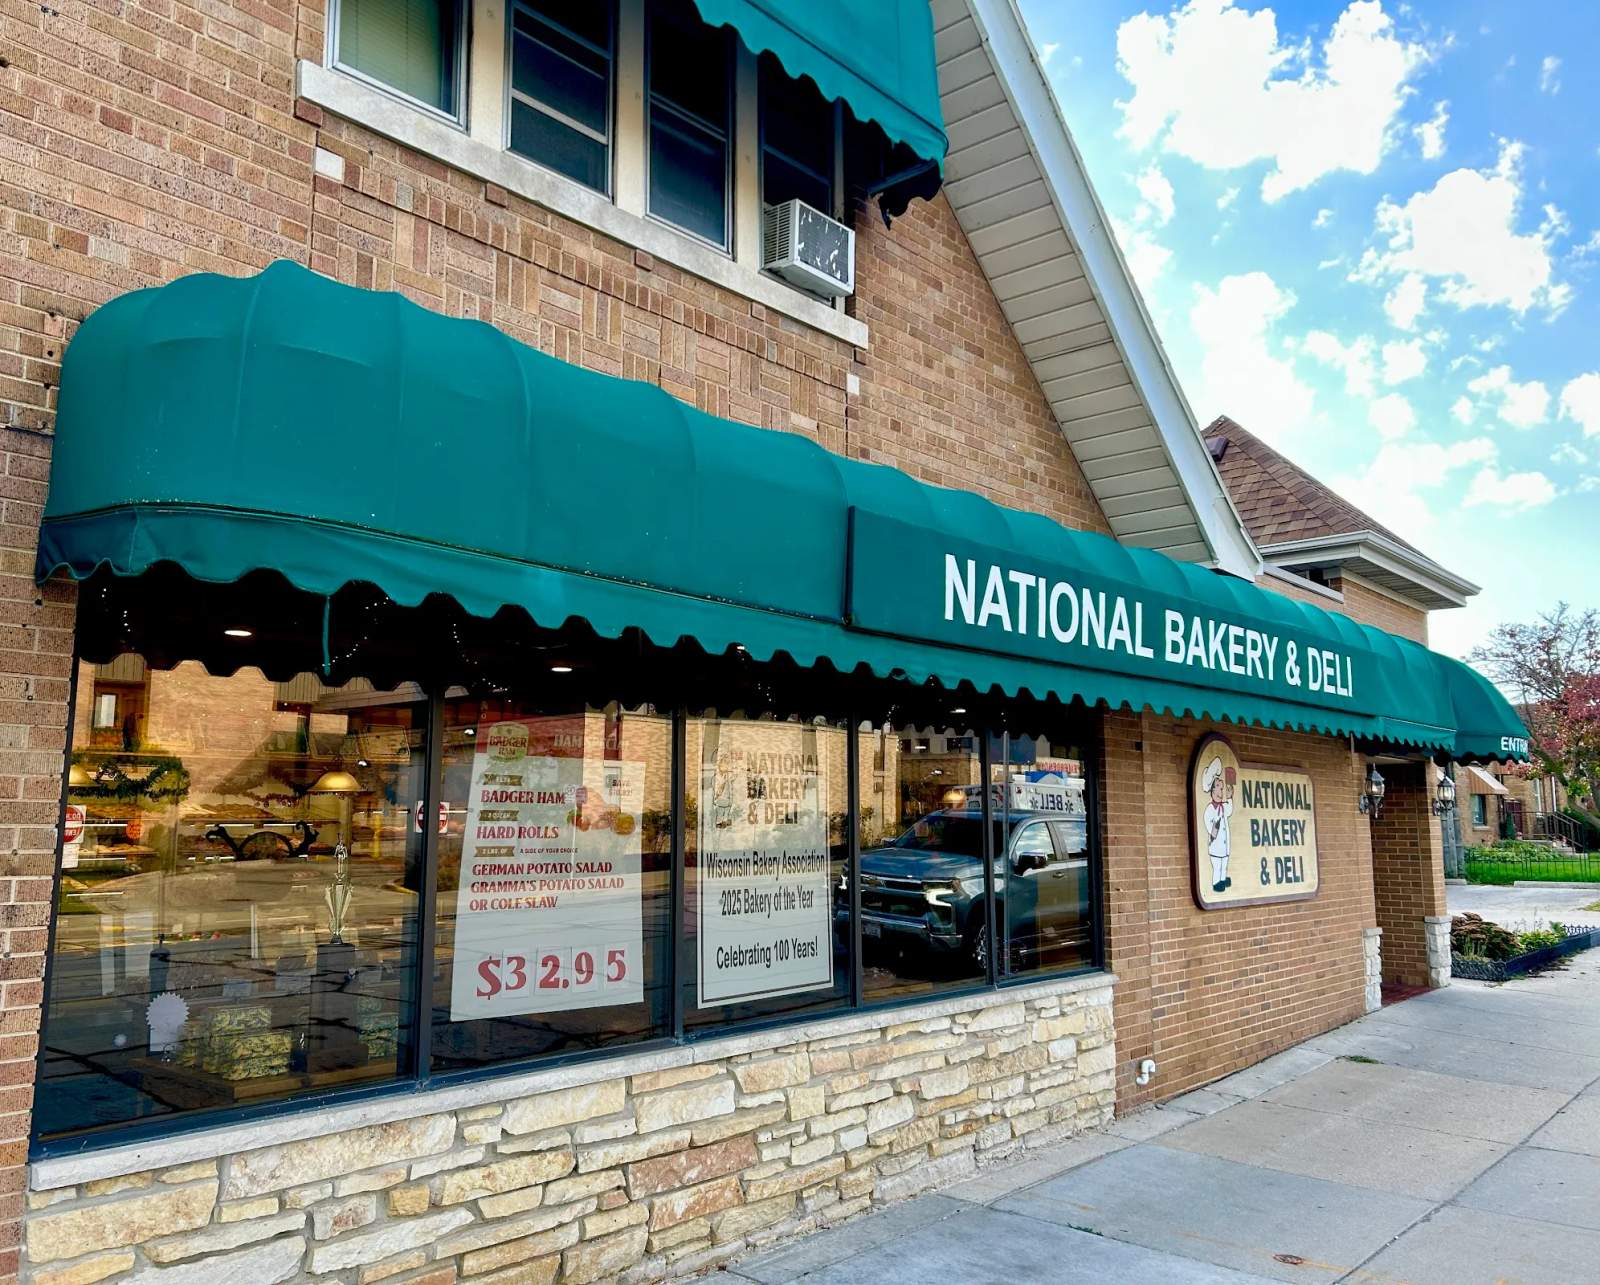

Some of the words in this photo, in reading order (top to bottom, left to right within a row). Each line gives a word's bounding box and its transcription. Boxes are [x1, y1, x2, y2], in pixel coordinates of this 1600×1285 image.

[943, 553, 1154, 659] NATIONAL
[1164, 608, 1279, 681] BAKERY
[1285, 639, 1302, 687] &
[1307, 646, 1354, 698] DELI
[480, 789, 534, 804] BADGER
[537, 791, 566, 805] HAM
[746, 776, 809, 800] BAKERY
[1242, 780, 1311, 811] NATIONAL
[747, 802, 759, 825] &
[764, 802, 798, 825] DELI
[476, 825, 515, 840] HARD
[518, 825, 559, 840] ROLLS
[1250, 818, 1306, 848] BAKERY
[472, 862, 524, 877] GERMAN
[527, 861, 573, 875] POTATO
[575, 861, 613, 874] SALAD
[706, 850, 751, 880] Wisconsin
[753, 851, 780, 881] Bakery
[782, 848, 825, 873] Association
[1260, 856, 1271, 886] &
[1275, 855, 1304, 885] DELI
[471, 880, 537, 894] GRAMMA'S
[538, 878, 586, 892] POTATO
[587, 877, 625, 890] SALAD
[469, 898, 488, 912] OR
[490, 898, 523, 911] COLE
[524, 895, 558, 909] SLAW
[721, 890, 742, 916] 2025
[744, 890, 772, 919] Bakery
[773, 888, 783, 911] of
[783, 888, 796, 911] the
[797, 884, 814, 909] Year
[716, 941, 772, 969] Celebrating
[773, 939, 790, 962] 100
[790, 935, 818, 959] Years!
[476, 949, 627, 1000] $32.95
